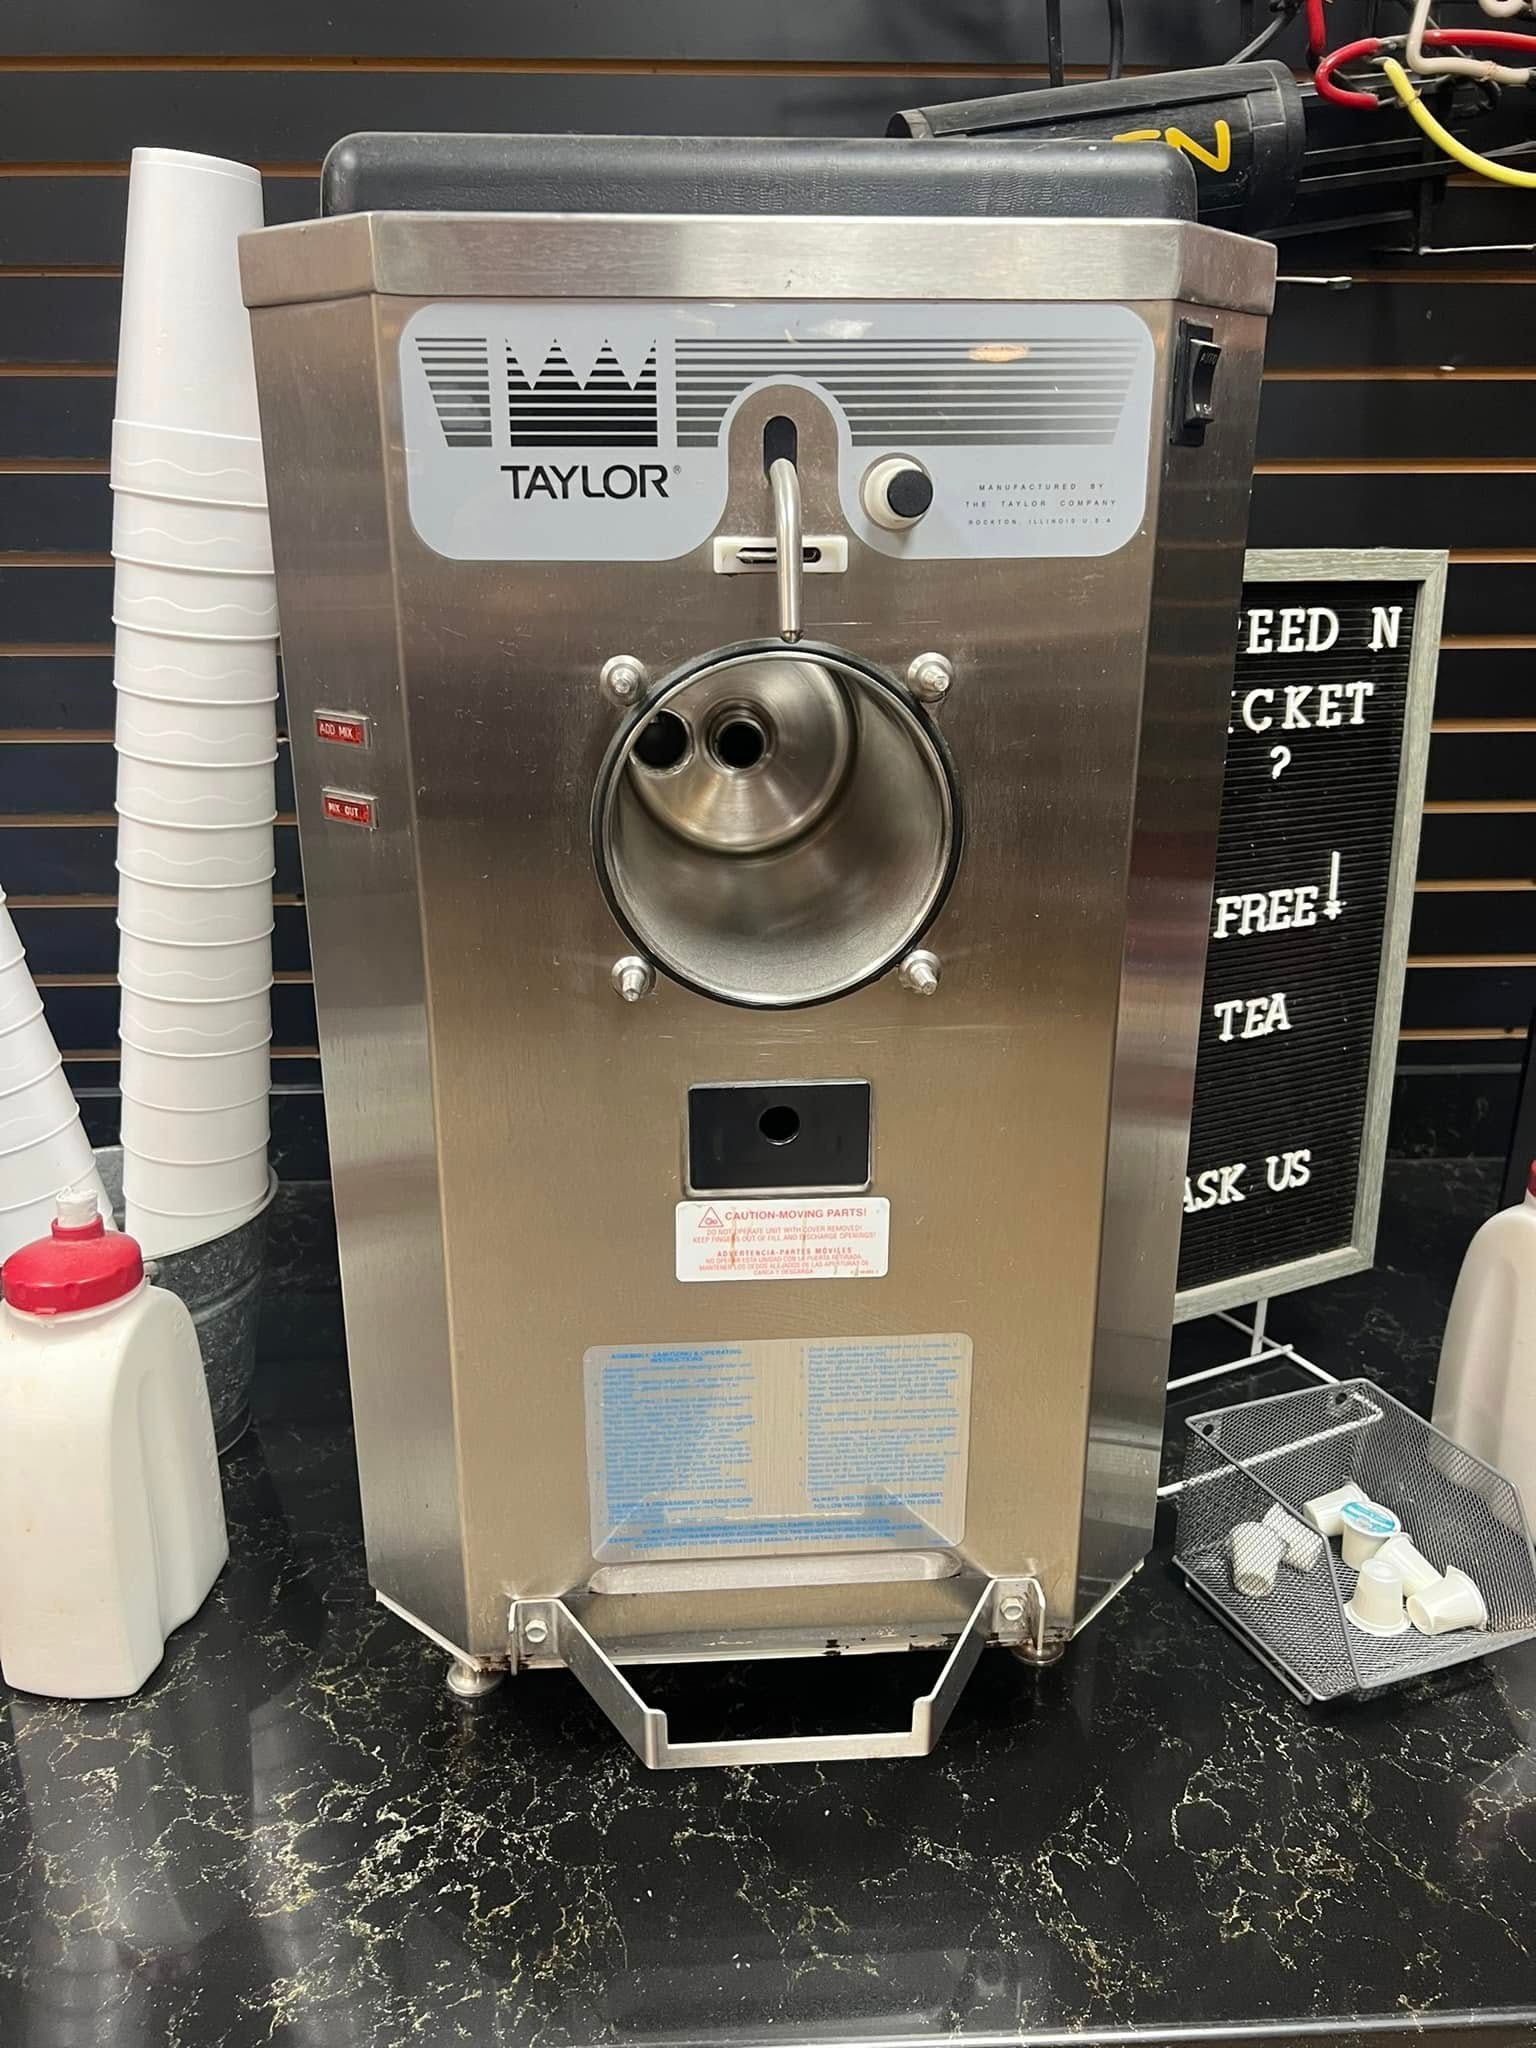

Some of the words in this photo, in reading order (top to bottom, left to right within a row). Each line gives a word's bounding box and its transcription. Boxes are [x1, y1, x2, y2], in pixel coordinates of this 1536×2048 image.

[1112, 119, 1231, 172] N
[500, 464, 670, 500] TAYLOR
[978, 482, 1077, 492] MANUFACTURED
[1090, 482, 1104, 490] BY
[964, 500, 988, 508] THE
[1001, 499, 1047, 508] TAYLOR
[1059, 498, 1117, 508] COMPANY
[1238, 607, 1340, 654] EED
[1368, 606, 1403, 652] N
[1227, 682, 1375, 734] CKET
[319, 722, 336, 736] ADD
[338, 725, 353, 739] MIX
[1270, 745, 1292, 780] ?
[344, 805, 359, 818] OUT
[1213, 992, 1293, 1042] TEA
[1265, 1149, 1312, 1192] US
[725, 1209, 824, 1221] CAUTION-MOVING
[827, 1207, 867, 1218] PARTS!
